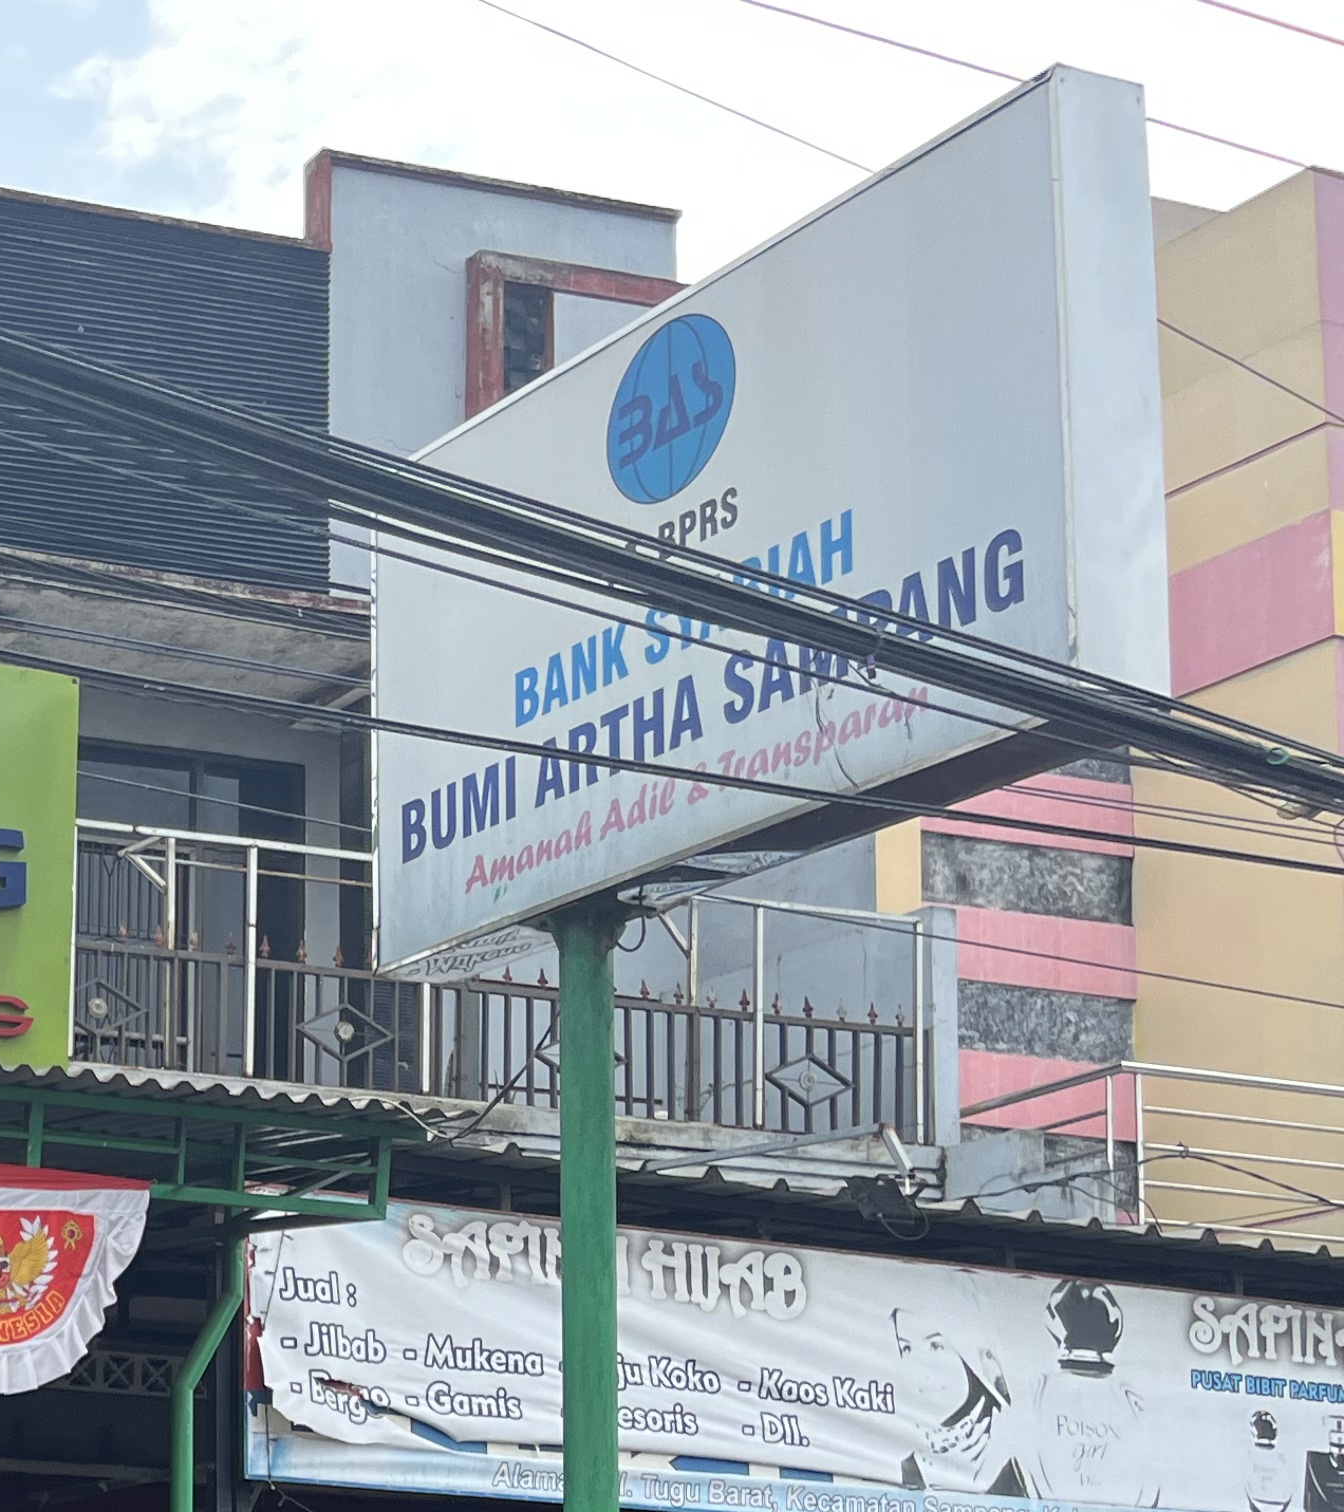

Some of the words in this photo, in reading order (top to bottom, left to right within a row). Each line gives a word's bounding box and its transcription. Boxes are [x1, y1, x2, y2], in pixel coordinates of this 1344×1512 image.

[515, 621, 629, 728] BANK
[402, 756, 517, 864] BUMI
[534, 674, 704, 809] ARTHA
[465, 810, 592, 895] Amanah
[599, 777, 677, 840] Adil
[279, 1266, 340, 1305] Jual
[303, 1321, 387, 1364] Jilbab
[424, 1334, 545, 1377] Mukena
[648, 1355, 721, 1394] Koko
[758, 1366, 830, 1407] Kaos
[832, 1376, 896, 1415] Kaki
[424, 1380, 523, 1421] Gamis
[1190, 1368, 1242, 1393] PUSAT
[1244, 1374, 1287, 1399] BIBIT
[640, 1473, 701, 1508] Tugu
